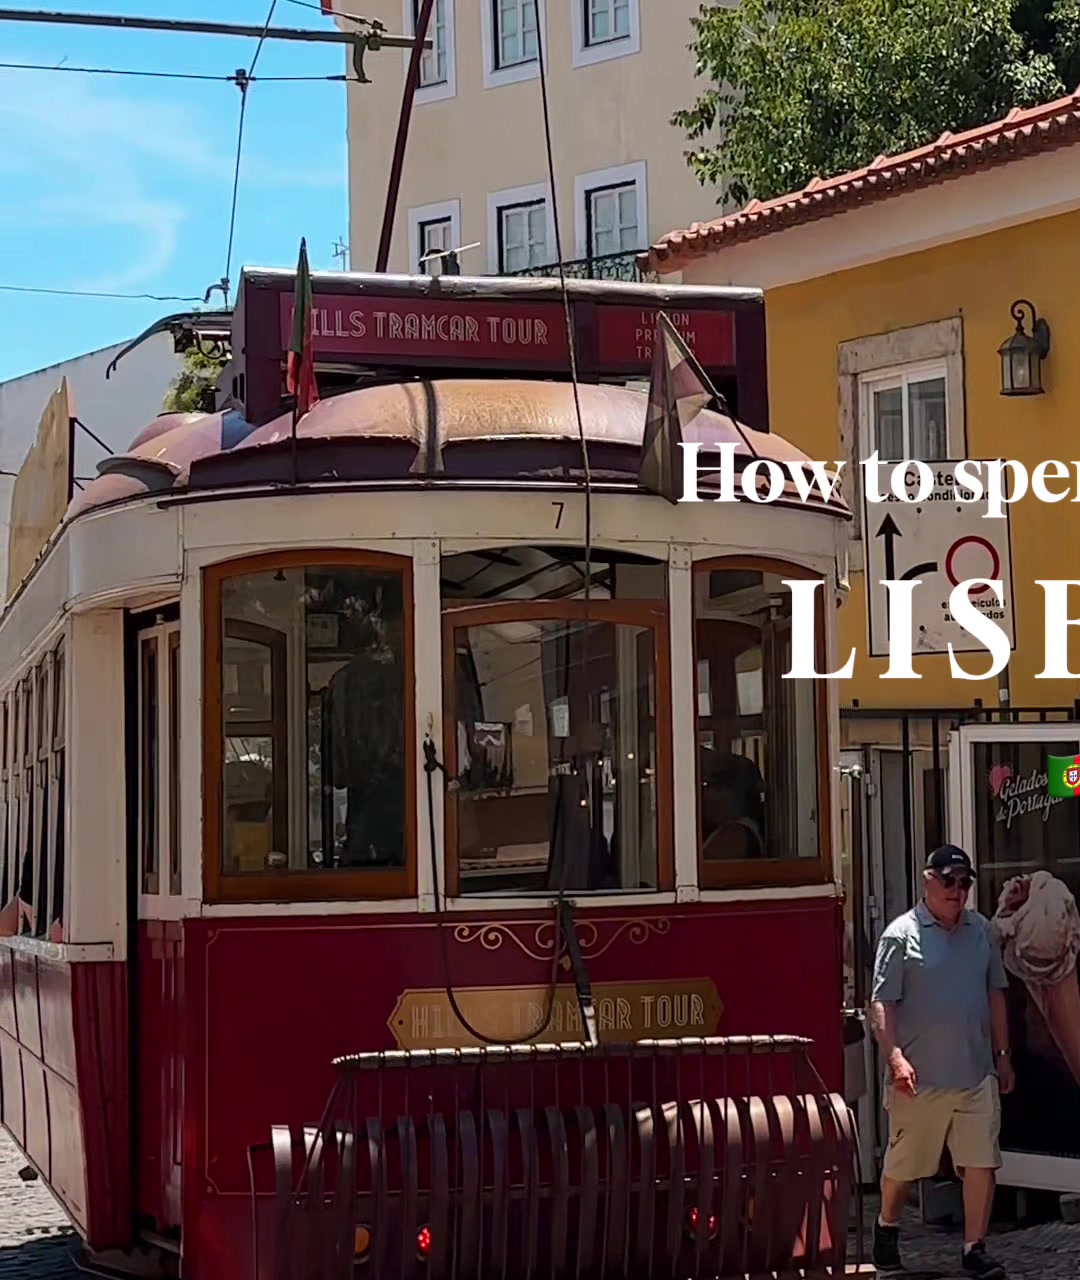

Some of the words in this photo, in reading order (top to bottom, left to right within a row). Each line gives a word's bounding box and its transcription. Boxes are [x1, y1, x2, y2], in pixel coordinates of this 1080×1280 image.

[291, 307, 366, 338] ILLS
[373, 311, 480, 342] TRAMCAR
[487, 316, 548, 345] TOUR
[551, 502, 564, 529] 7
[1000, 769, 1048, 801] Gelados
[639, 993, 705, 1028] TOUR
